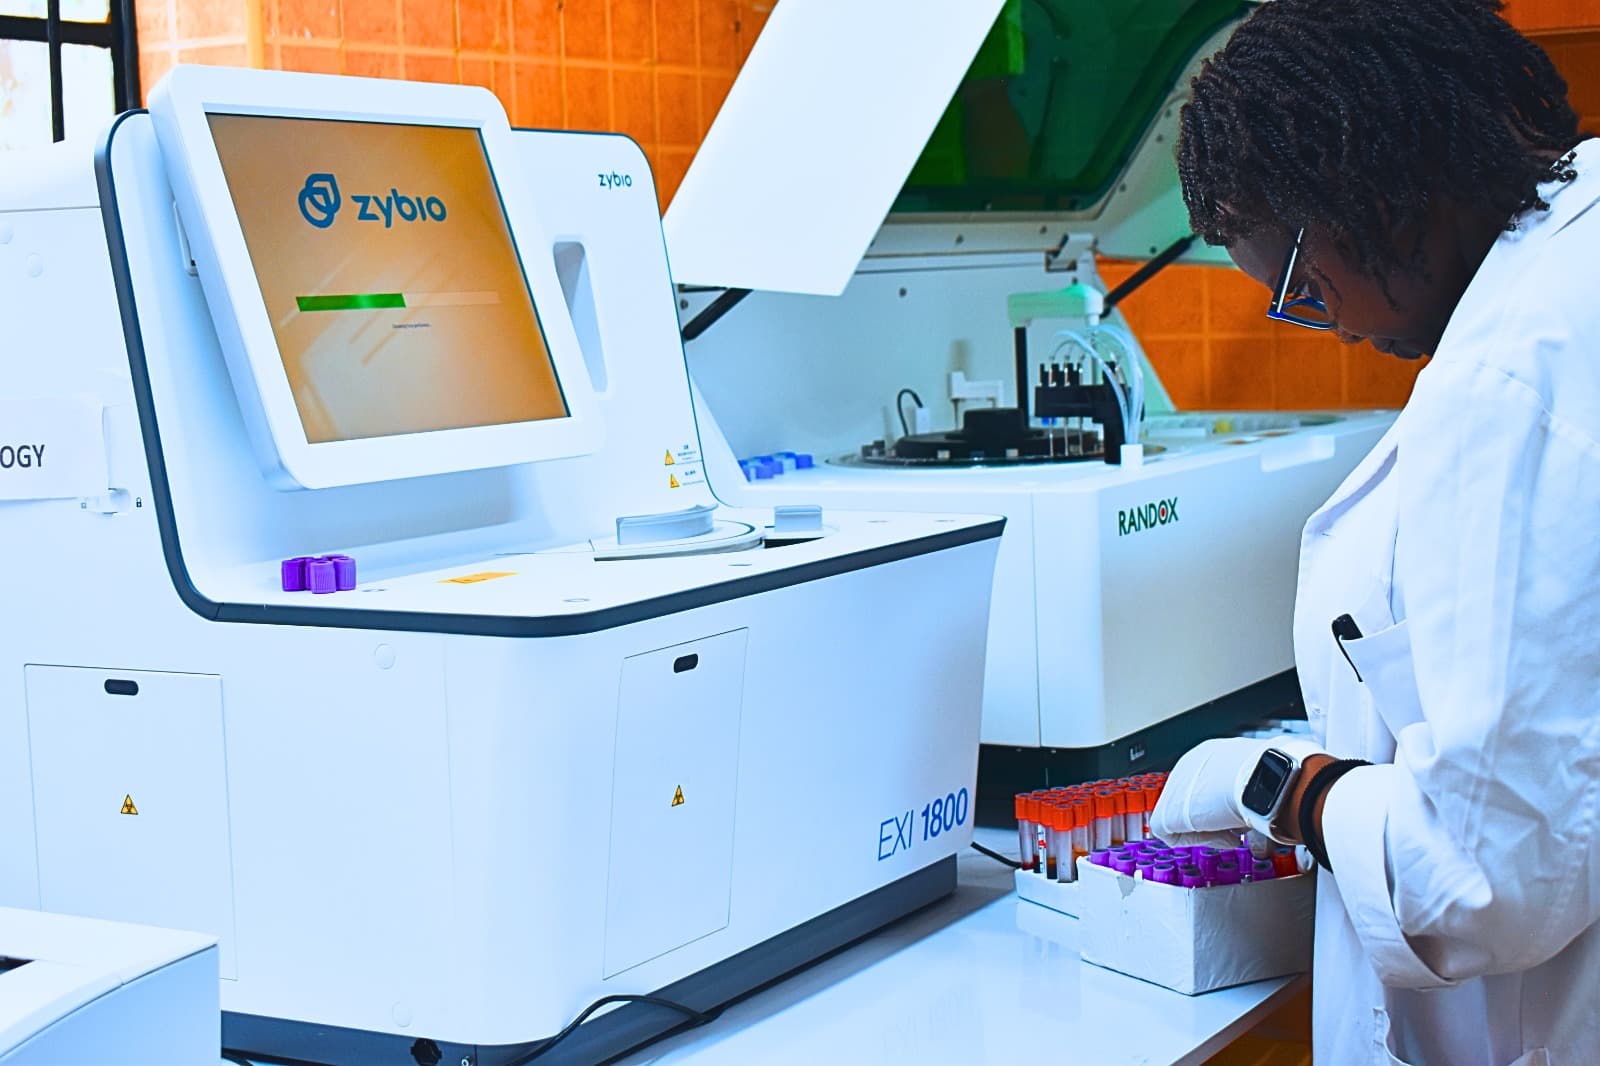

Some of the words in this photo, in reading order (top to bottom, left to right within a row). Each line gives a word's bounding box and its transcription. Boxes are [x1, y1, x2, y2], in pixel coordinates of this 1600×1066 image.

[598, 171, 632, 190] zybio
[350, 188, 447, 228] zybio
[0, 444, 45, 468] OGY
[1119, 496, 1179, 536] RANDOX
[878, 809, 914, 861] EXI
[921, 787, 968, 841] 1800
